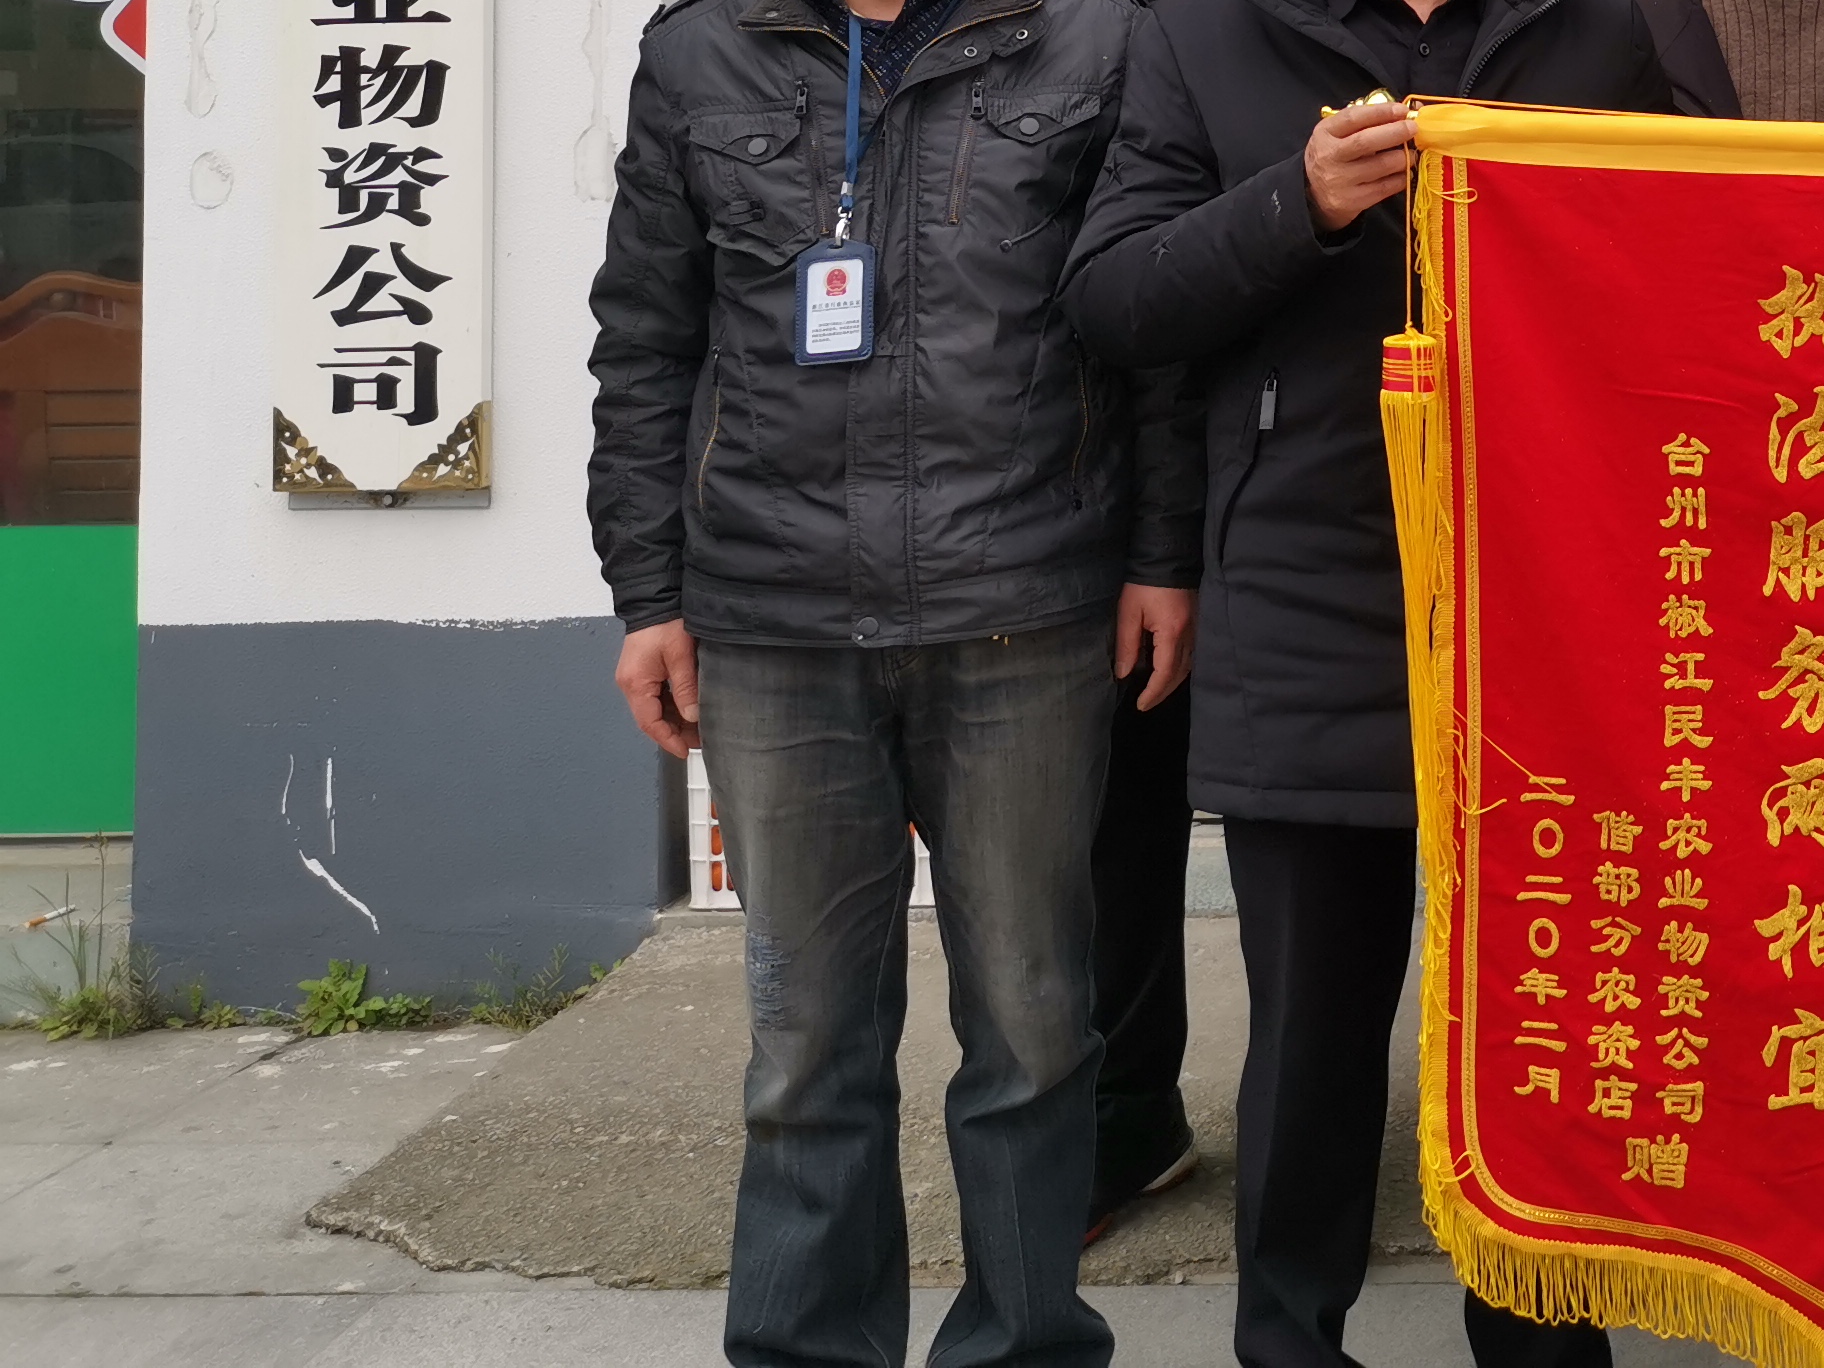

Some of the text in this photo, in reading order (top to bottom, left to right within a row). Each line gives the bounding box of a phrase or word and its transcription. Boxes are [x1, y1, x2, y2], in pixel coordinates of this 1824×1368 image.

[1655, 432, 1715, 1123] 台州市椒江民丰农业物资公司
[1587, 809, 1644, 1121] 偕部分农资店
[1621, 1132, 1689, 1190] 赠
